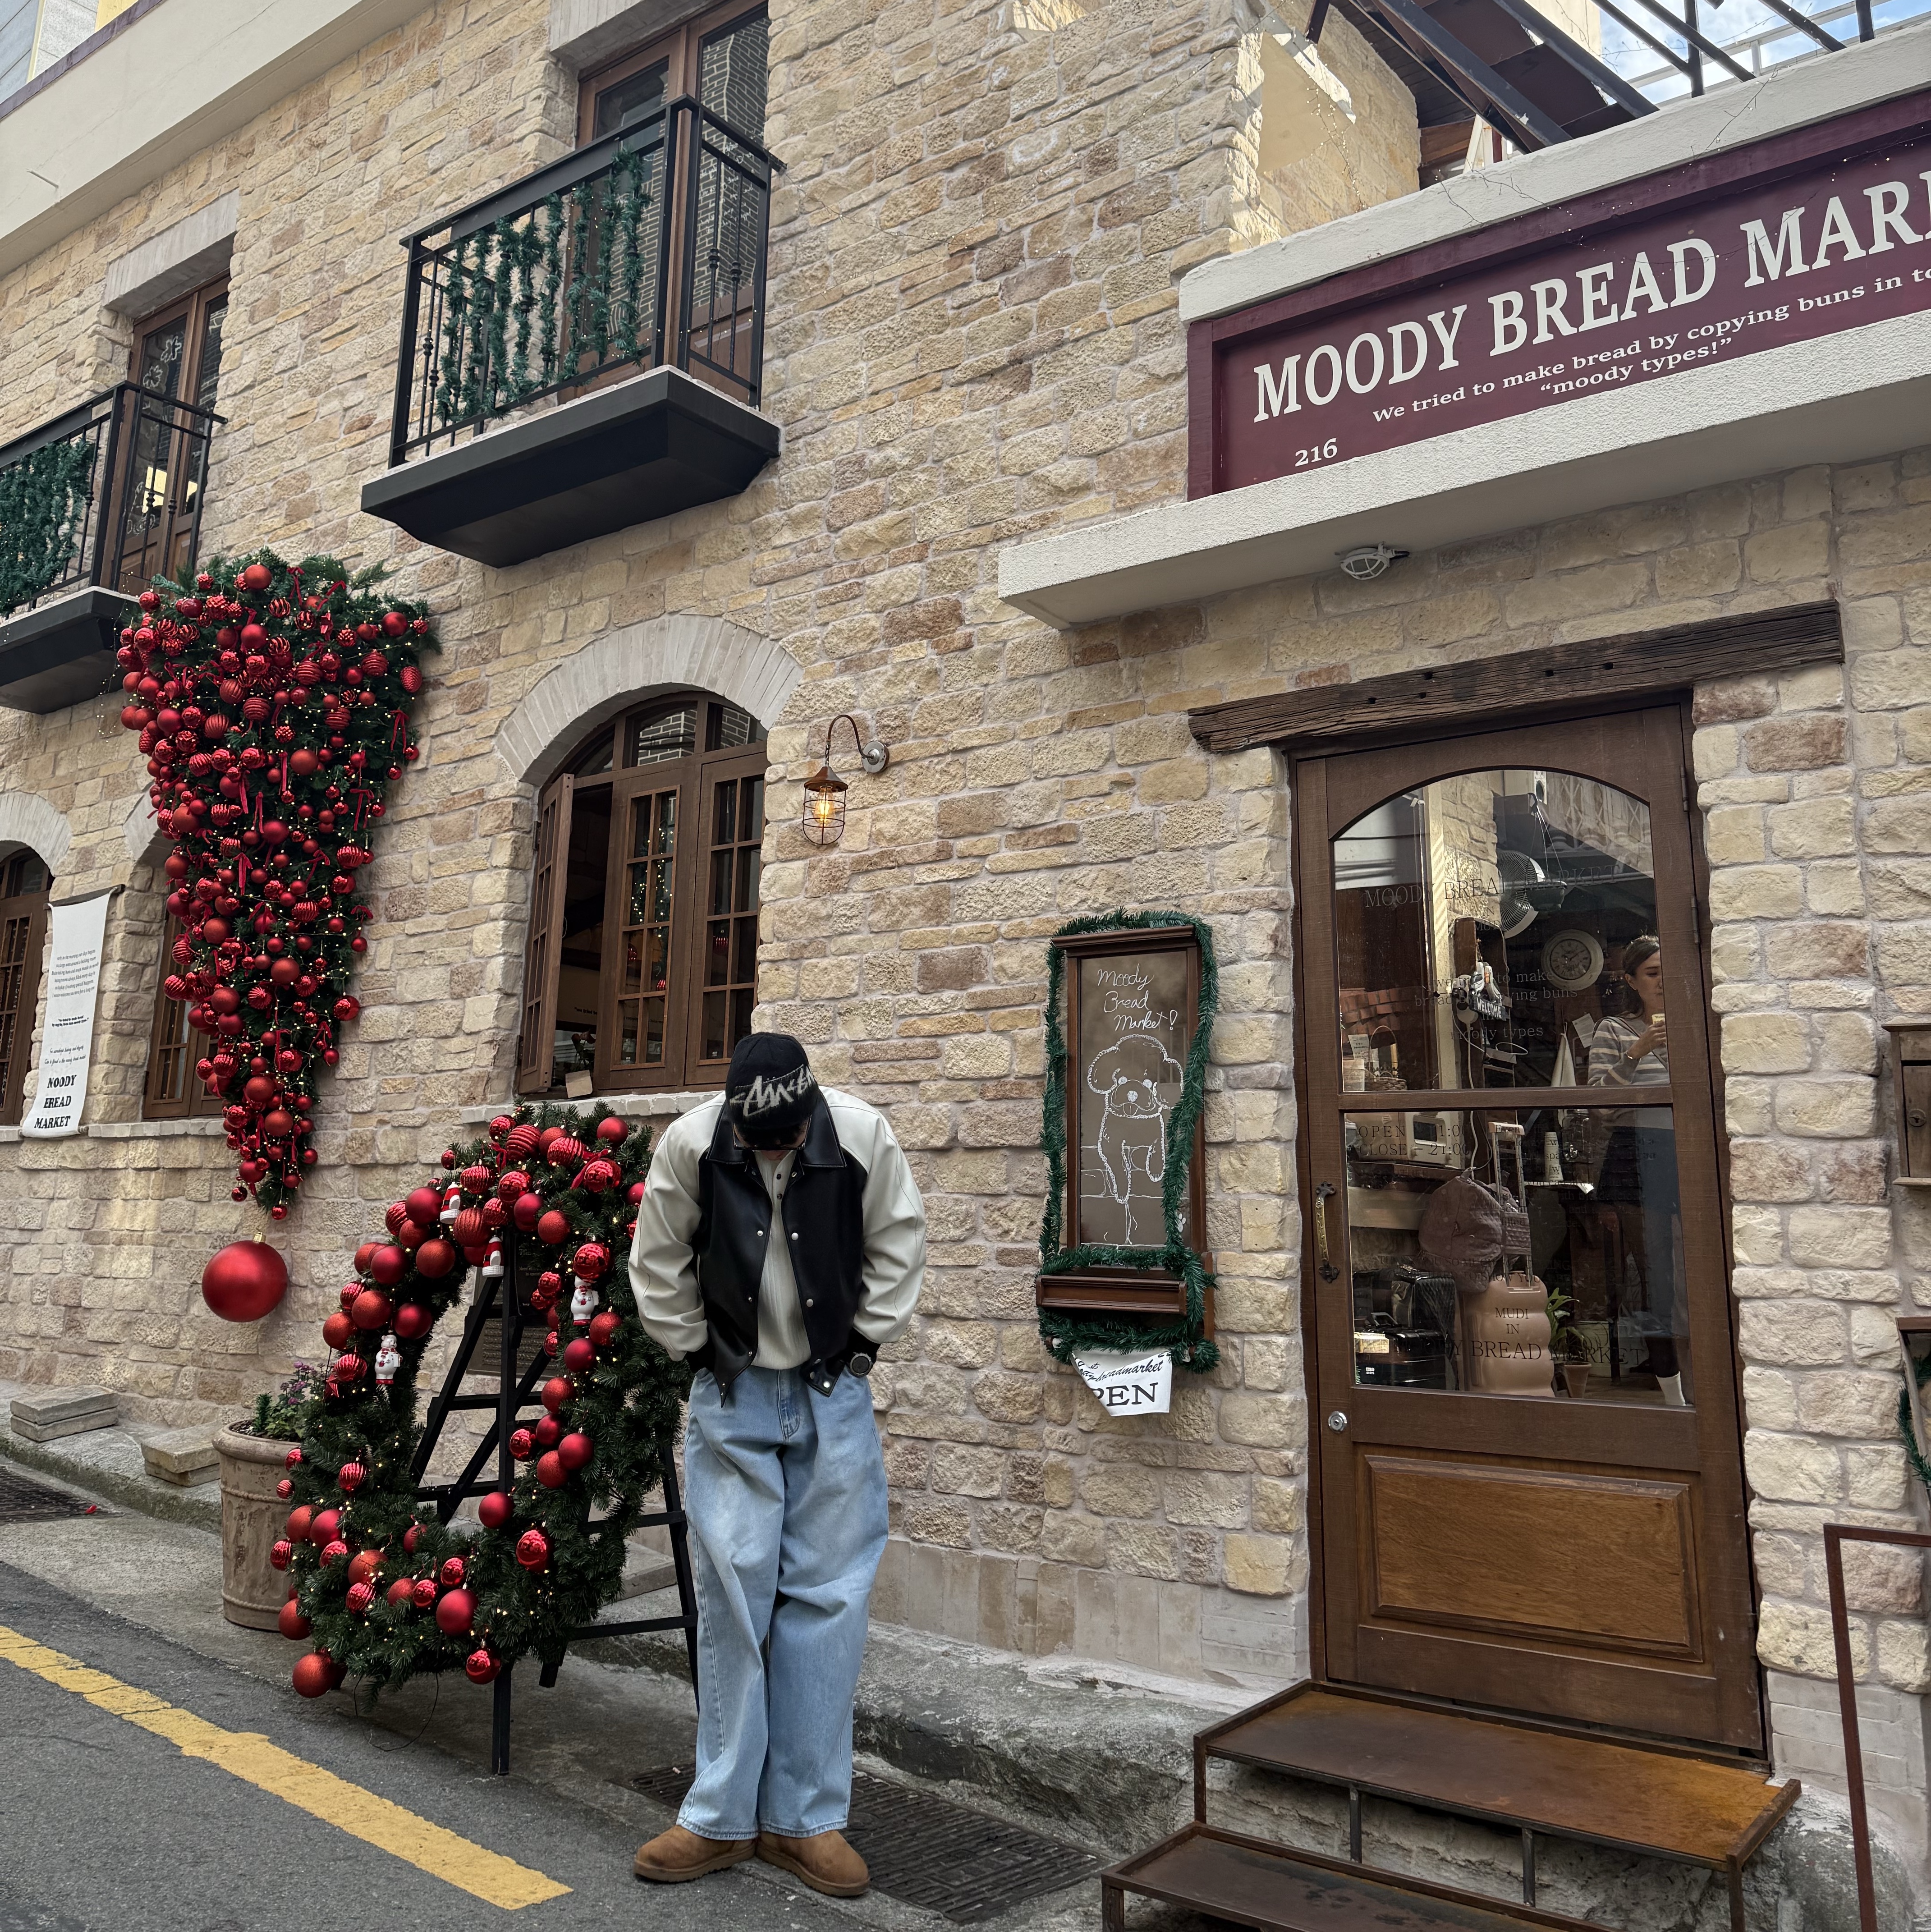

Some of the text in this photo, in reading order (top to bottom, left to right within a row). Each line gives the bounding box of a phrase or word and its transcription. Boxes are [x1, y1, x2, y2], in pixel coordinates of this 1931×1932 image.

[1254, 170, 1931, 423] MOODY BREAD MAR
[1412, 387, 1466, 412] tried
[1472, 381, 1495, 395] to
[1502, 363, 1564, 388] make
[1572, 340, 1642, 370] bread
[1649, 333, 1679, 351] by
[1687, 305, 1789, 340] copying
[1798, 285, 1865, 311] buns
[1874, 276, 1903, 293] in
[1295, 437, 1338, 467] 216
[1365, 883, 1435, 908] MOOD
[1444, 876, 1514, 899] BREA
[1097, 963, 1155, 990] Moody
[1497, 973, 1510, 984] to
[1516, 969, 1554, 982] make
[1104, 990, 1150, 1013] Bread
[1543, 987, 1578, 998] buns
[1477, 997, 1502, 1019] WELCOME
[1503, 1026, 1544, 1039] types
[34, 1115, 71, 1129] MARKET
[1358, 1125, 1405, 1138] OPEN
[1359, 1143, 1408, 1156] CLOSE
[1428, 1143, 1470, 1156] 21:00
[1495, 1307, 1529, 1319] MUDI
[1505, 1323, 1519, 1334] IN
[1472, 1340, 1542, 1360] BREAD
[1549, 1345, 1645, 1365] MRKET
[1091, 1382, 1159, 1407] PEN
